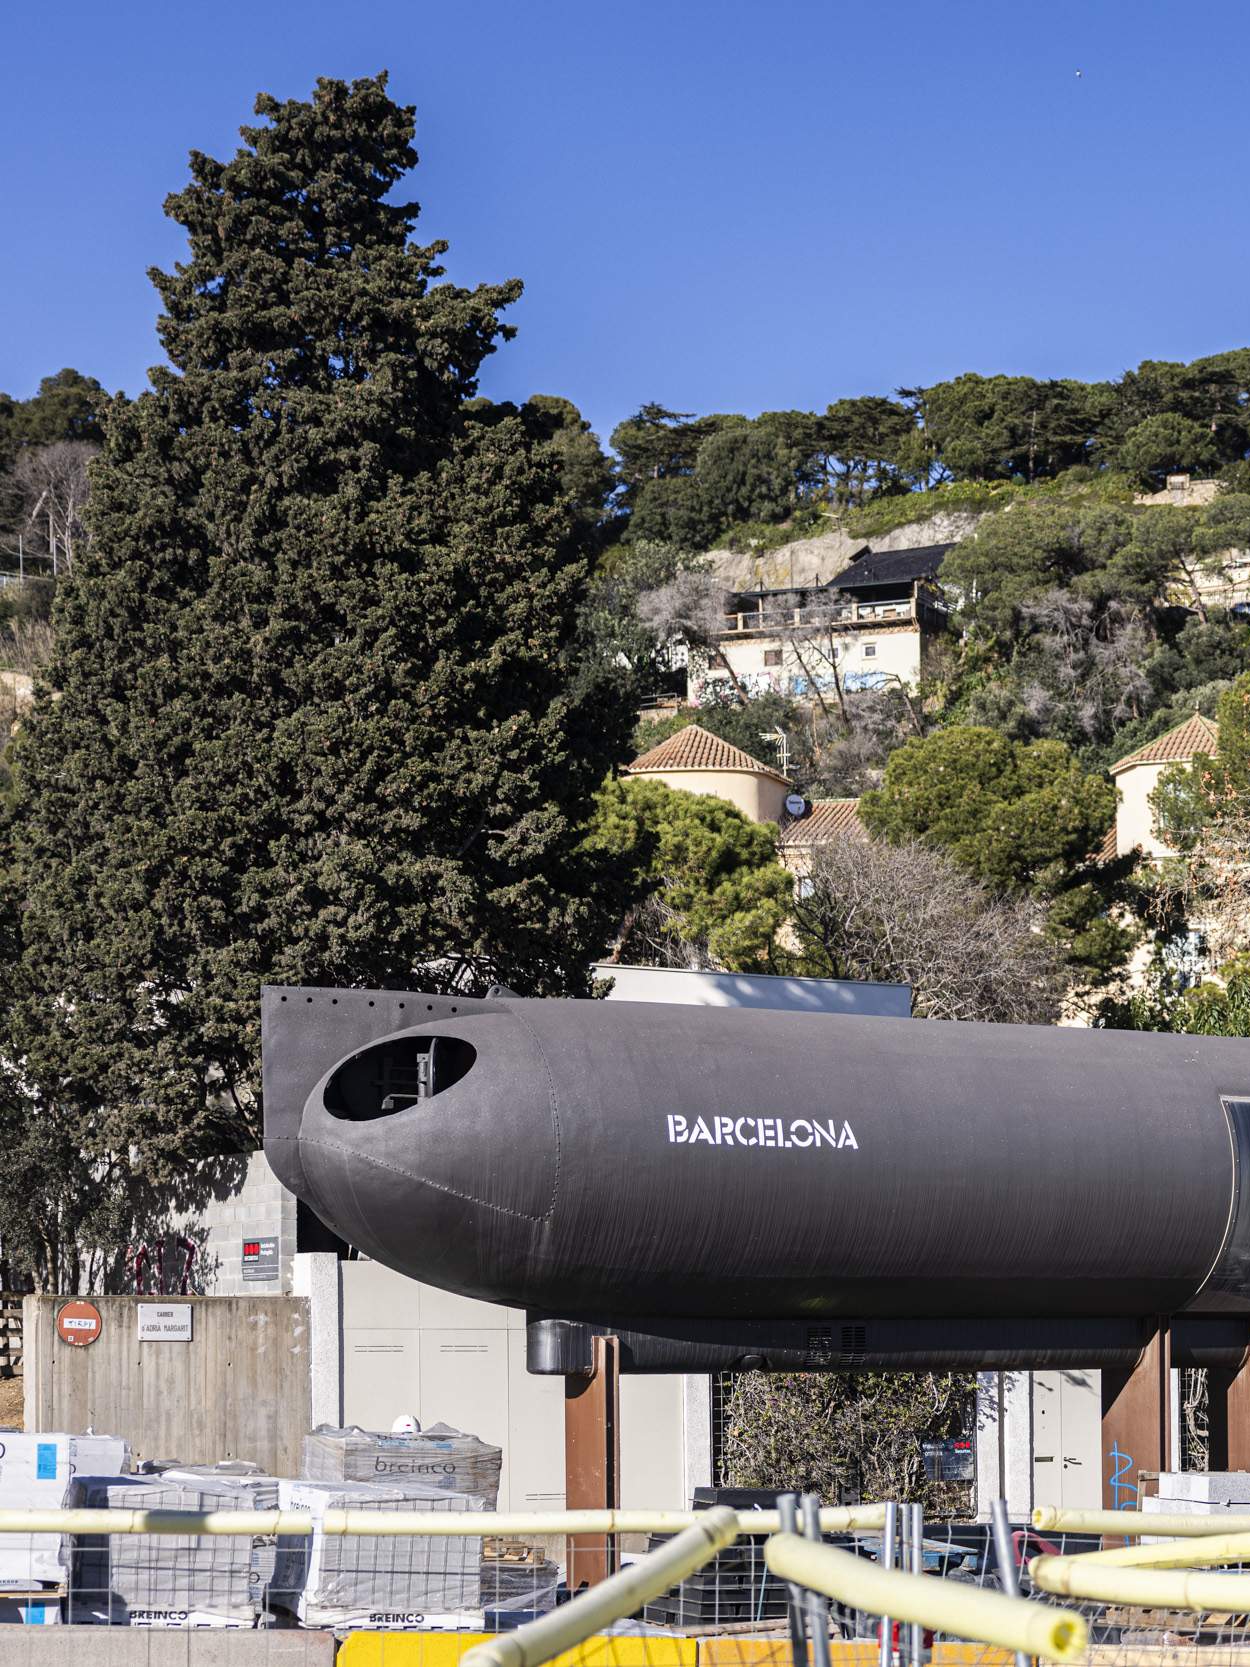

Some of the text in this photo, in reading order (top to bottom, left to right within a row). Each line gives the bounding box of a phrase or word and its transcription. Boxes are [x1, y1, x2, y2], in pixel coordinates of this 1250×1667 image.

[667, 1114, 859, 1149] BARCELONA
[163, 1324, 189, 1332] MARGARIT
[375, 1456, 456, 1474] breinco
[129, 1610, 188, 1620] BREINCO
[369, 1613, 425, 1623] BREINCO
